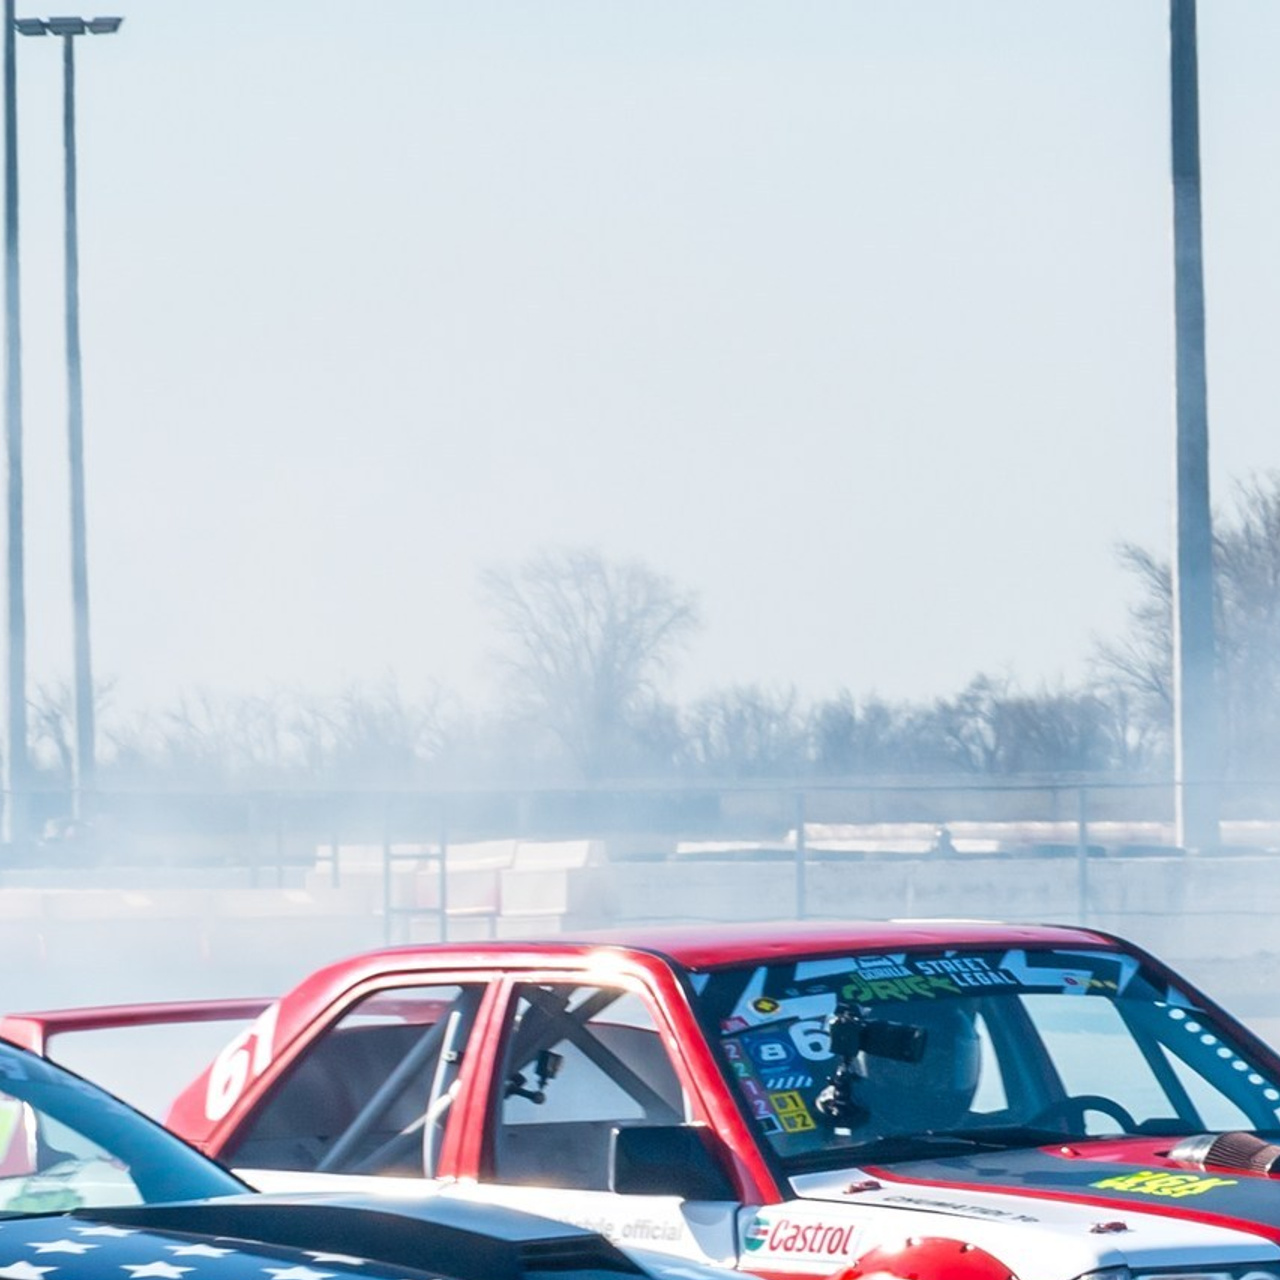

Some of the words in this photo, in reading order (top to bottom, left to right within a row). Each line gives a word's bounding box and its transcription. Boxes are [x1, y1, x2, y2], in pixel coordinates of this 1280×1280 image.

[858, 965, 914, 981] GORILLA
[915, 957, 992, 976] STREET
[949, 971, 1017, 986] LEGAL
[205, 1001, 280, 1121] 61
[769, 1219, 854, 1255] Castrol
